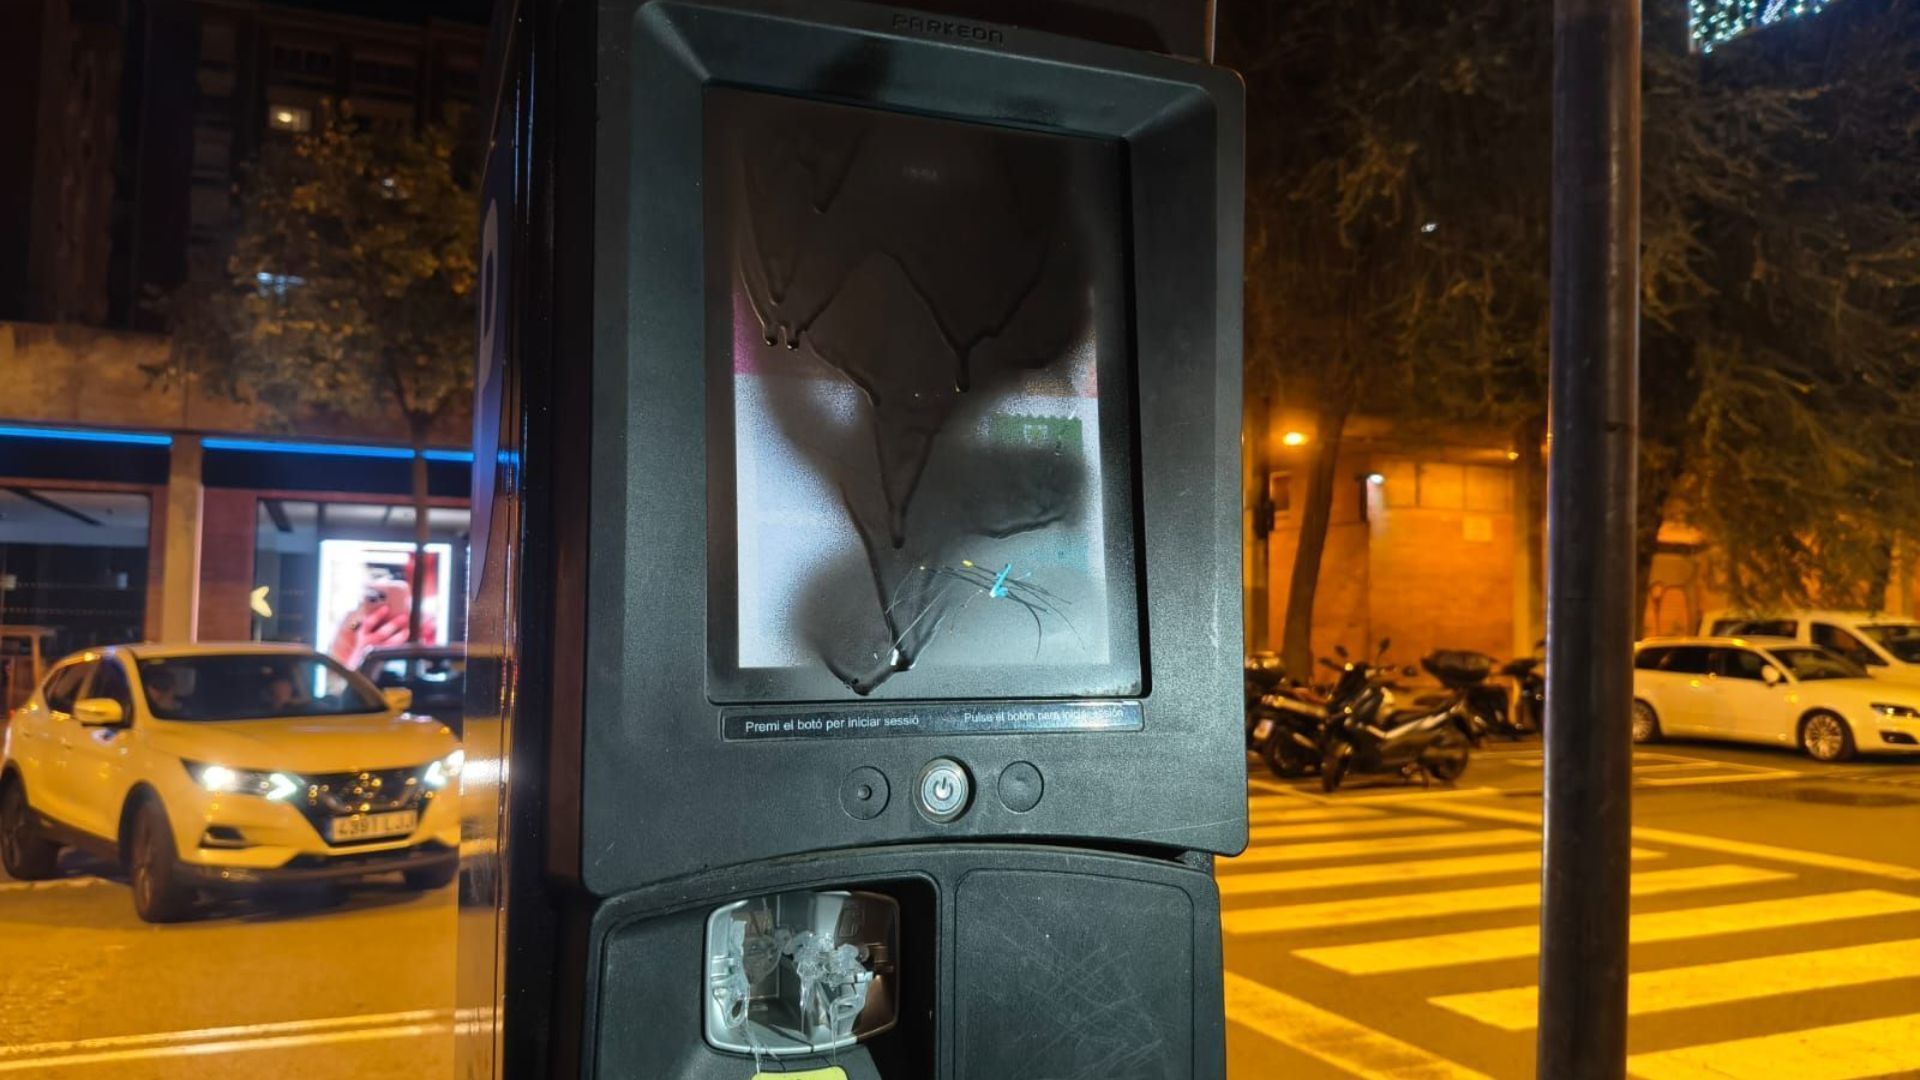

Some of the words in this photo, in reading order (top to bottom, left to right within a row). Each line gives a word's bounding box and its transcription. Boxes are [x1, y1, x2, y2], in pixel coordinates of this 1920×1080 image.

[892, 13, 1003, 42] PARKEON
[745, 720, 780, 733] Premi
[783, 719, 794, 731] el
[797, 718, 823, 730] botó
[826, 719, 845, 732] per
[848, 716, 882, 728] iniciar
[884, 715, 919, 727] sessió
[964, 712, 993, 723] Pulse
[995, 711, 1005, 722] el
[1007, 710, 1035, 721] botón
[1037, 711, 1060, 723] para
